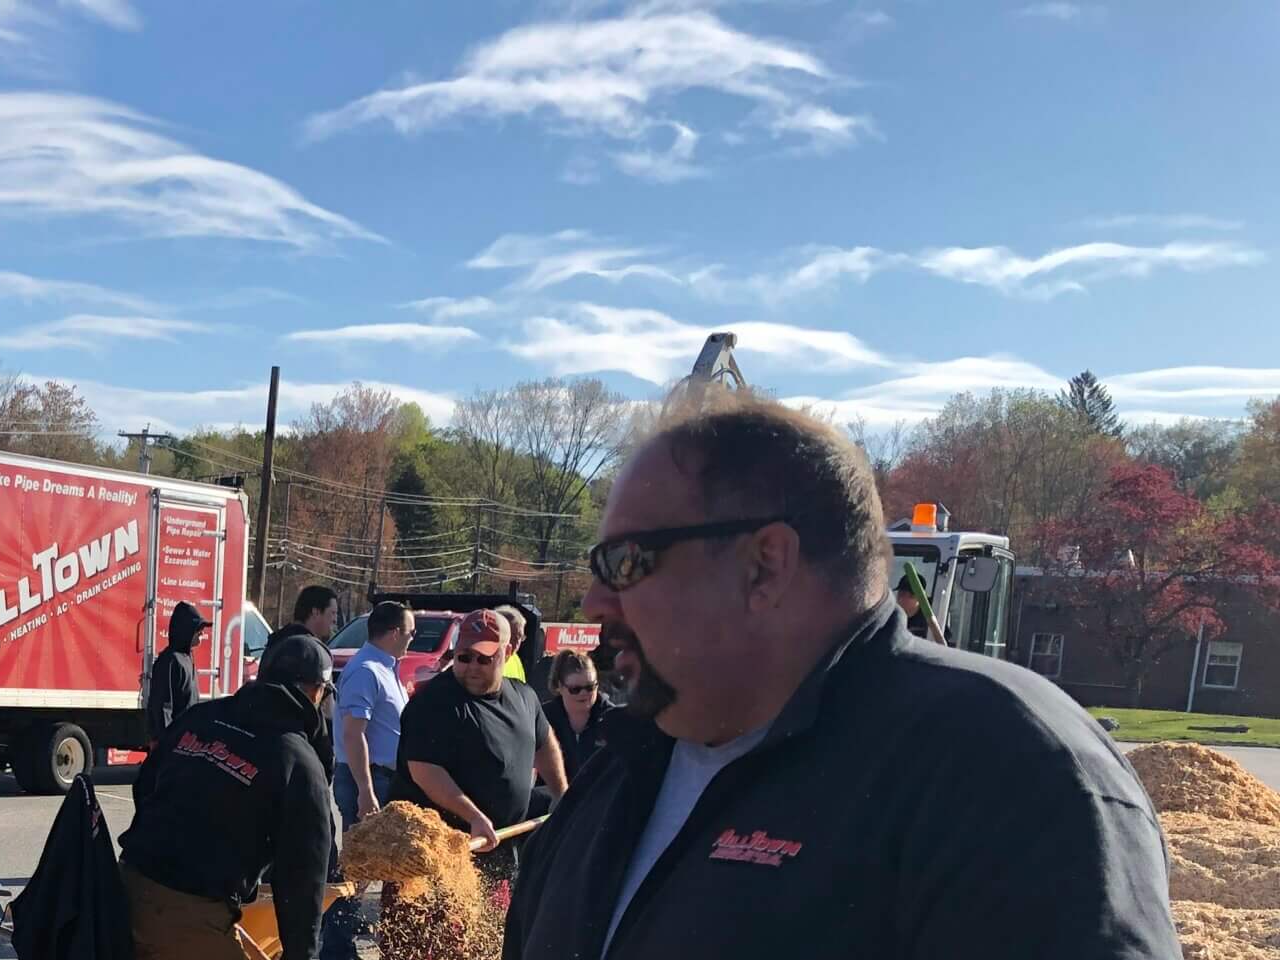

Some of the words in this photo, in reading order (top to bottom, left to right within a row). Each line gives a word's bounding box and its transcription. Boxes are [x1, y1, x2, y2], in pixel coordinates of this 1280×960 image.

[14, 474, 40, 492] Pipe
[43, 478, 84, 497] Dreams
[87, 485, 95, 498] A
[98, 487, 137, 506] Reality!
[185, 547, 192, 556] &
[164, 577, 177, 586] Line
[9, 613, 48, 641] HEATING
[56, 602, 69, 616] AC
[76, 585, 101, 604] DRAIN
[102, 562, 142, 591] CLEANING
